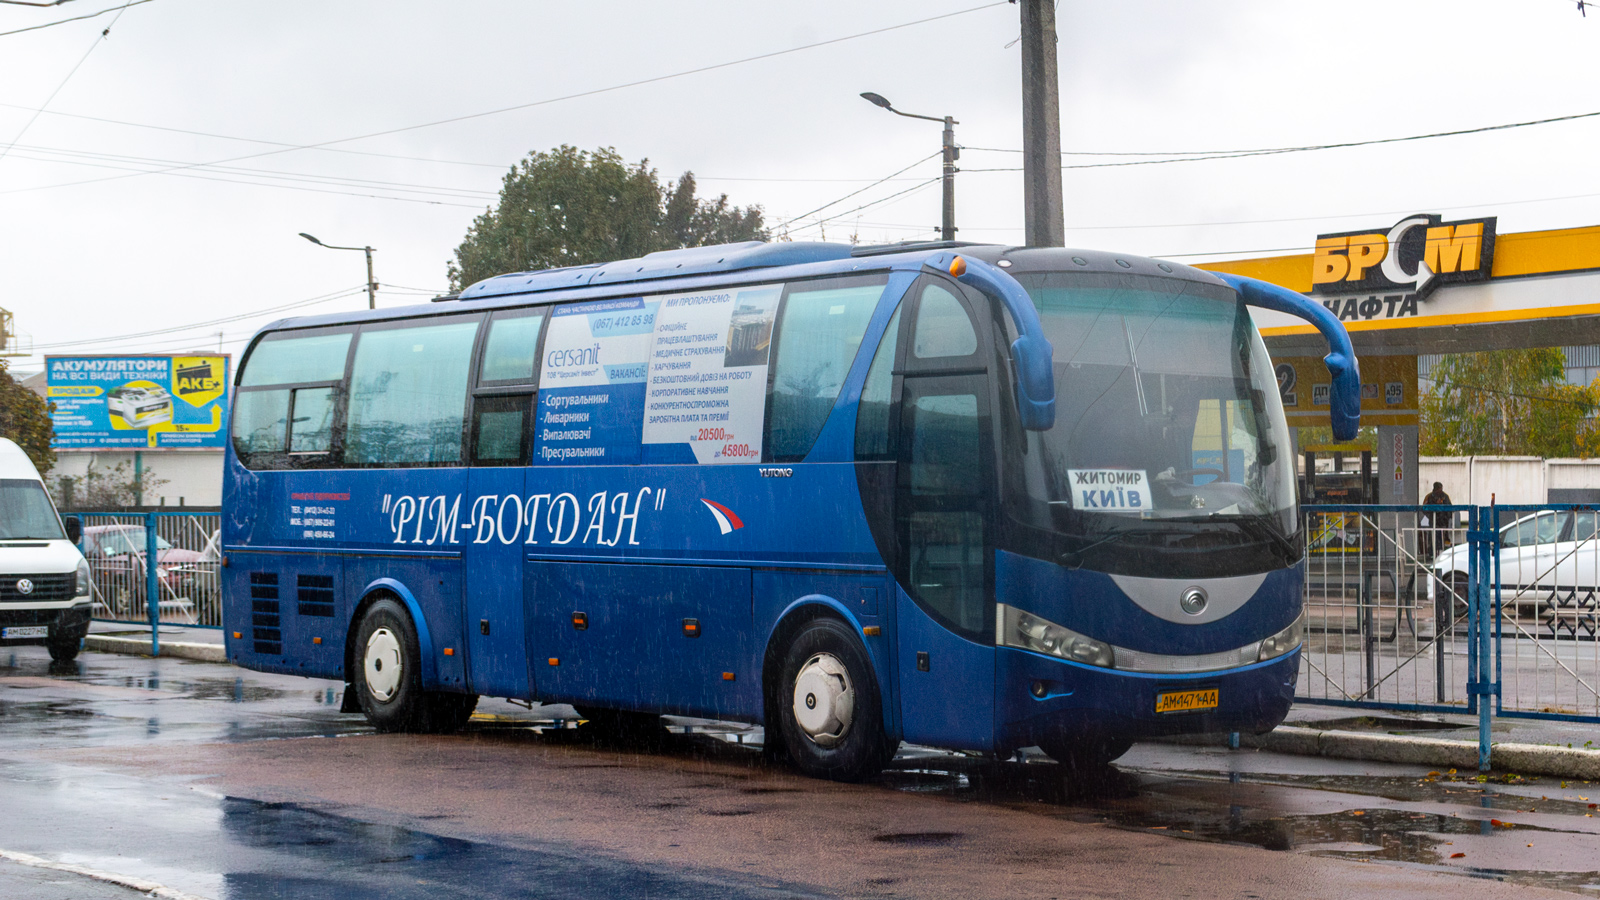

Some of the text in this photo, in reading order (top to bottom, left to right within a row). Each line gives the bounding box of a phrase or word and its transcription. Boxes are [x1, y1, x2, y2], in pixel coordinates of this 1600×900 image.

[1312, 214, 1484, 291] БРСМ
[666, 294, 731, 308] МИ ПРОПОНУЄМО:
[1323, 294, 1418, 321] НАФТА
[593, 314, 654, 331] (067) 412 85 98
[660, 322, 688, 332] ОФІЦІЙНЕ
[657, 333, 718, 345] ПРАЦЕВЛАШТУВАННЯ
[547, 343, 601, 368] cersanit
[656, 346, 725, 358] МЕДИЧНЕ СТРАХУВАННЯ
[52, 360, 168, 371] АКУМУЛЯТОРИ
[654, 362, 691, 371] ХАРЧУВАННЯ
[52, 372, 167, 381] НА ВСІ ВИДИ ТЕХНІКИ
[652, 371, 752, 384] БЕЗКОШТОВНИЙ ДОВІЗ НА РОБОТУ
[1276, 363, 1297, 406] 2
[1386, 385, 1401, 396] А95
[651, 386, 729, 397] КОРПОРАТИВНЕ НАВЧАННЯ
[1314, 386, 1328, 397] ДП
[546, 394, 609, 410] Сортувальники
[650, 400, 730, 410] КОНКУРЕНТНОСПРОМОЖНА
[544, 412, 590, 426] Ливарники
[649, 411, 729, 424] ЗАРОБІТНА ПЛАТА ТА ПРЕМІЇ
[543, 426, 592, 441] Випалювачі
[542, 446, 605, 461] Пресувальники
[759, 468, 793, 477] YUTONG
[1074, 472, 1141, 484] ЖИТОМИР
[1082, 487, 1142, 508] КИЇВ
